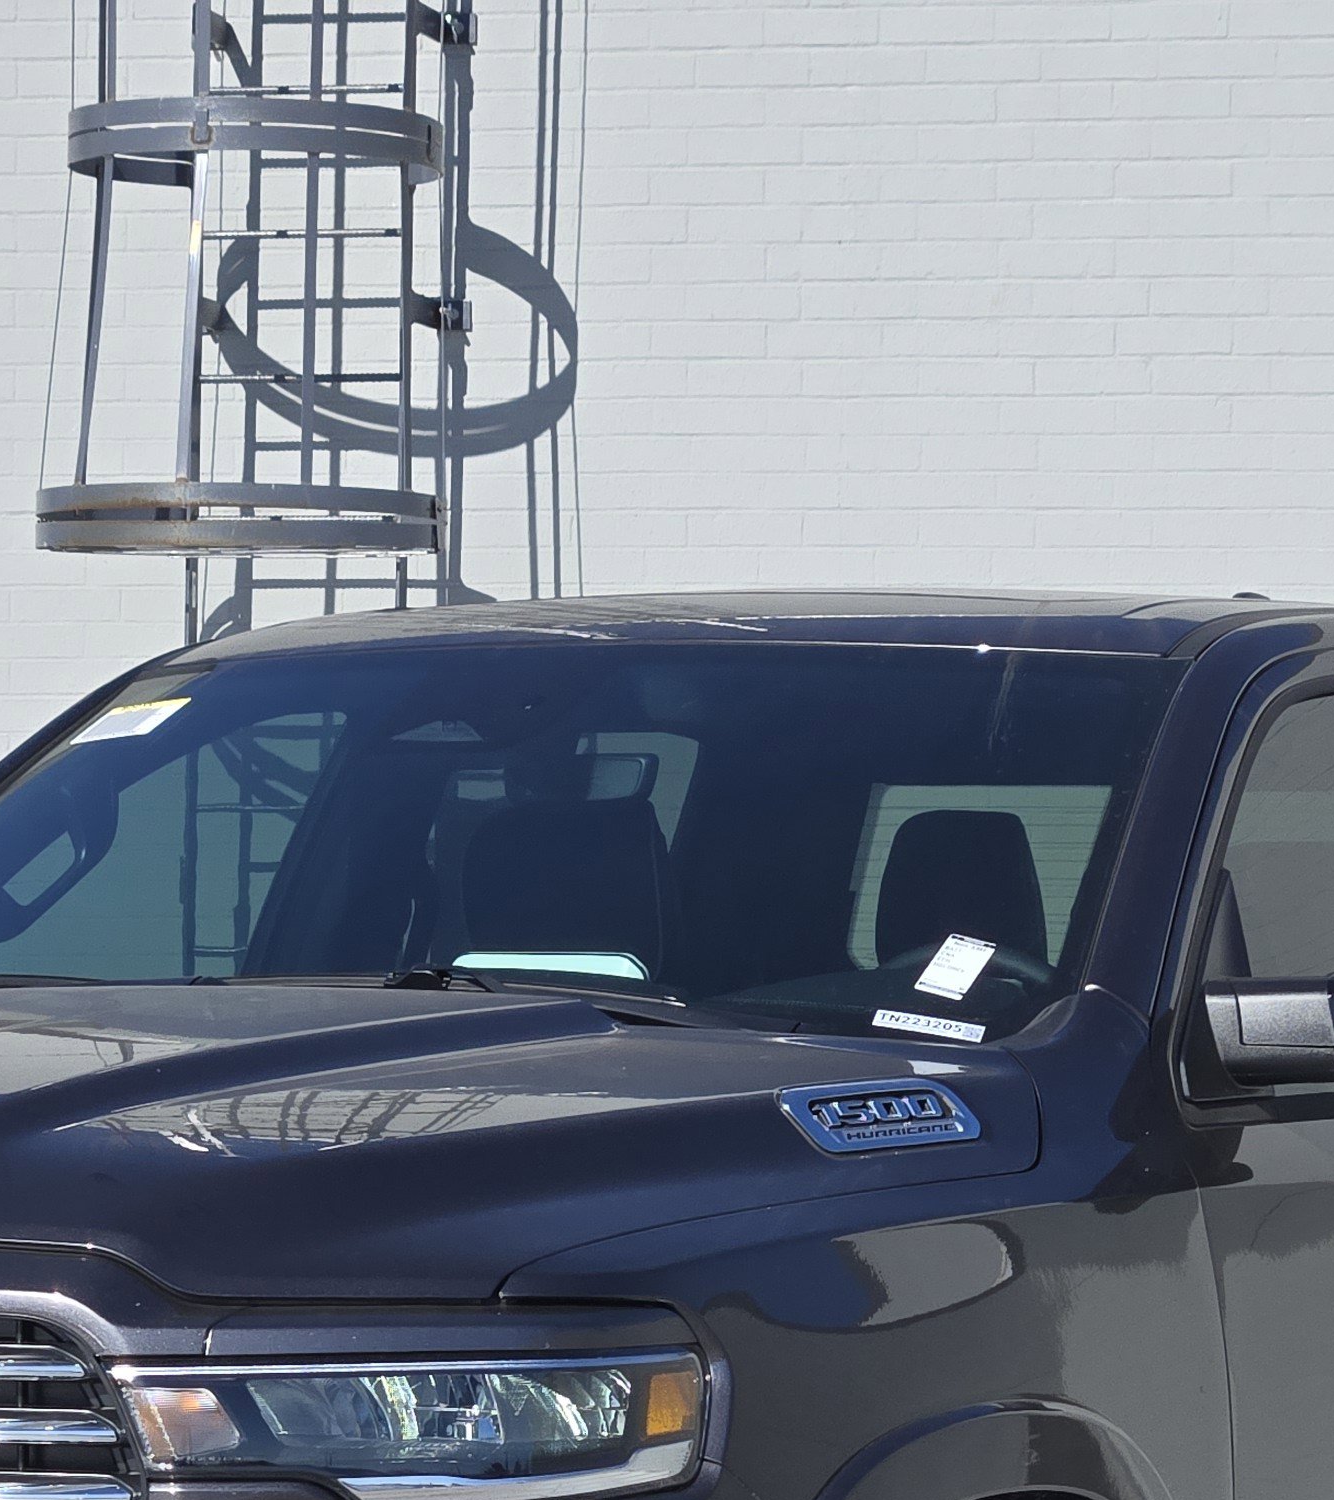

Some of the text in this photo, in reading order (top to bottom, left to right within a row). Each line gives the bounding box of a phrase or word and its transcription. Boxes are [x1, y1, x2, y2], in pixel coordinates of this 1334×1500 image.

[878, 1011, 963, 1033] TN223205
[812, 1094, 944, 1131] 1500
[846, 1122, 957, 1141] HURRICANE
